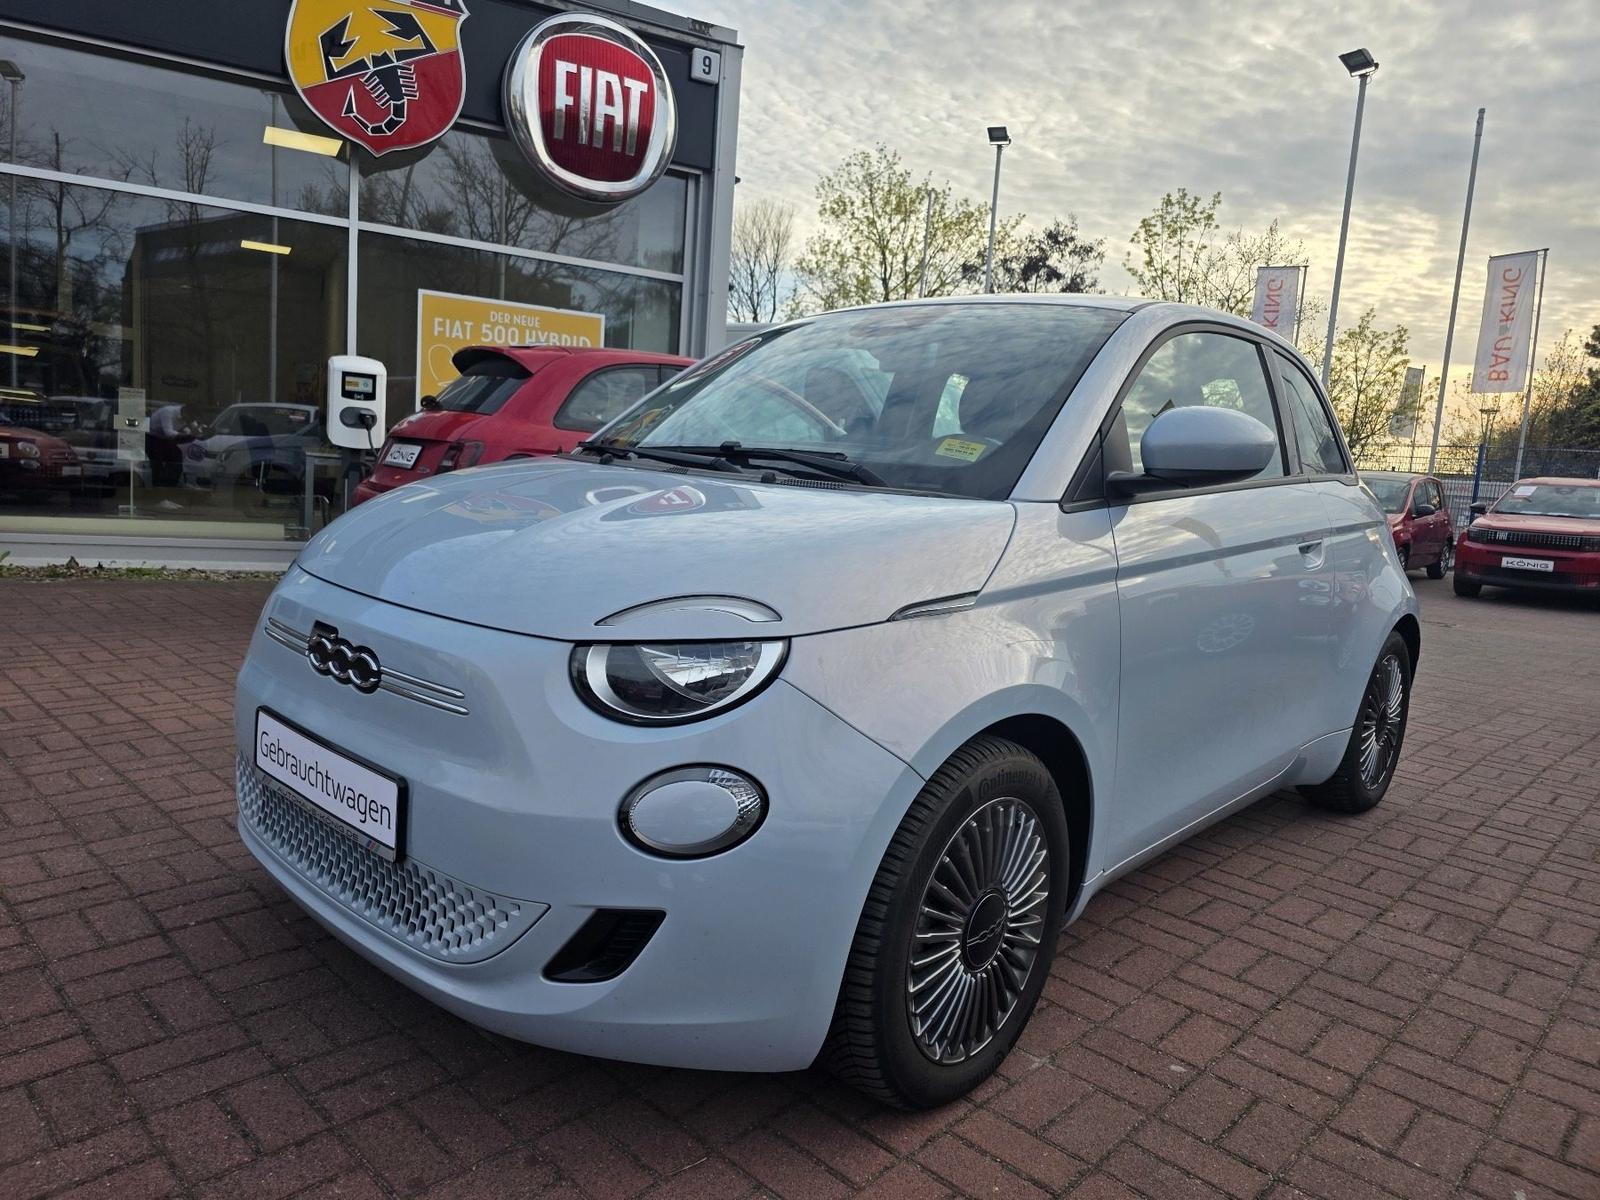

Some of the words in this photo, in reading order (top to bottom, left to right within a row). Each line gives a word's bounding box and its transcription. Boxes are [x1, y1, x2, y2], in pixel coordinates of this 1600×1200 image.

[702, 55, 712, 76] 9
[553, 59, 648, 157] FIAT
[490, 311, 510, 325] DER
[513, 314, 541, 329] NEUE
[433, 317, 474, 340] FIAT
[480, 323, 519, 346] 500
[525, 328, 591, 348] HYBRID
[389, 448, 416, 463] KÖNIG
[1505, 559, 1549, 569] KÖNIG
[259, 731, 392, 830] Gebrauchtwagen
